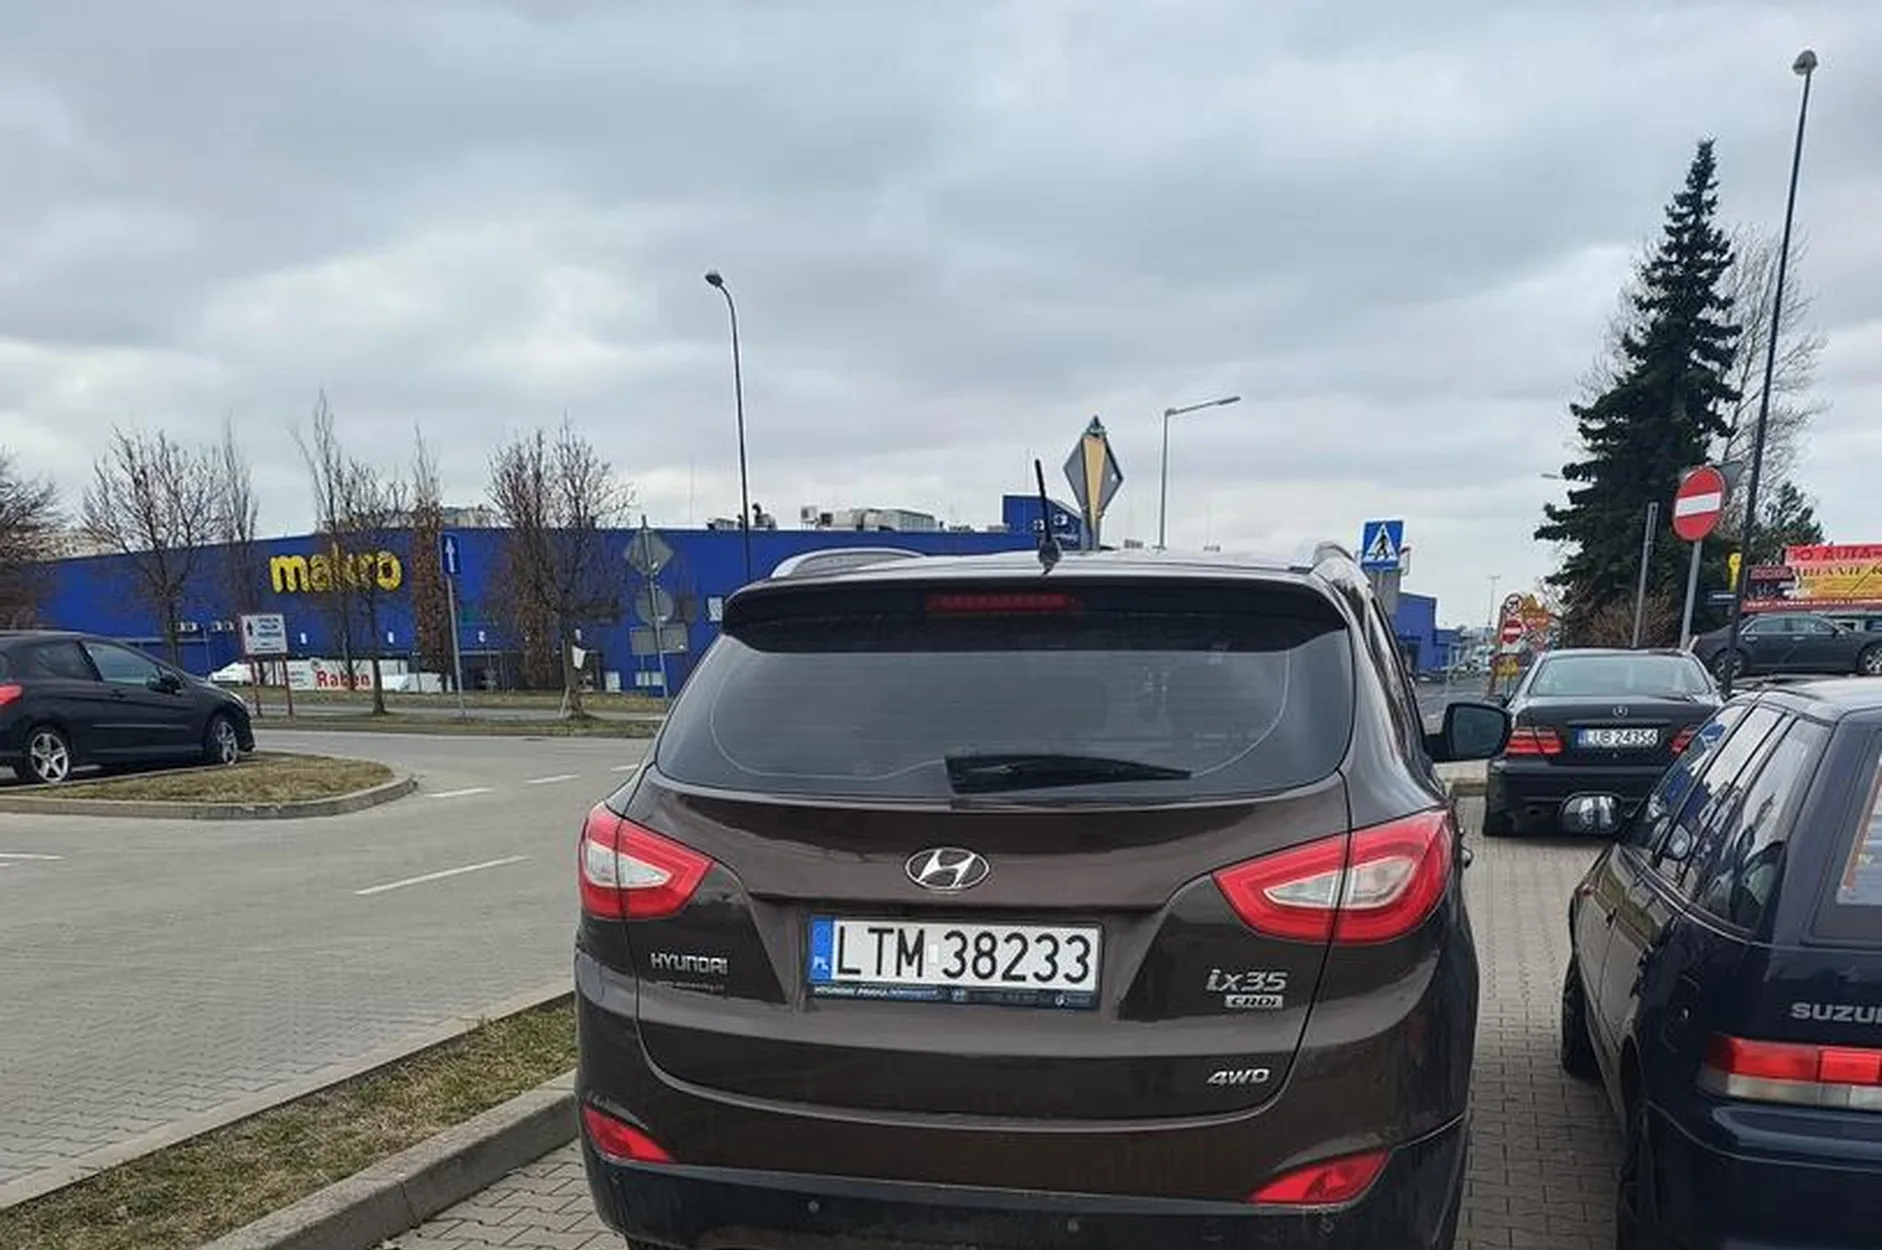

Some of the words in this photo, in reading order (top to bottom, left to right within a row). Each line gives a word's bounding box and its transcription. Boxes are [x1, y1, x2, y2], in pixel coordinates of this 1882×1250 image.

[270, 541, 402, 593] makro
[650, 952, 728, 976] HYUNDAI
[836, 926, 925, 978] LTM
[942, 930, 1092, 984] 38233
[1206, 968, 1288, 992] ix35
[1206, 1068, 1270, 1084] 4WD
